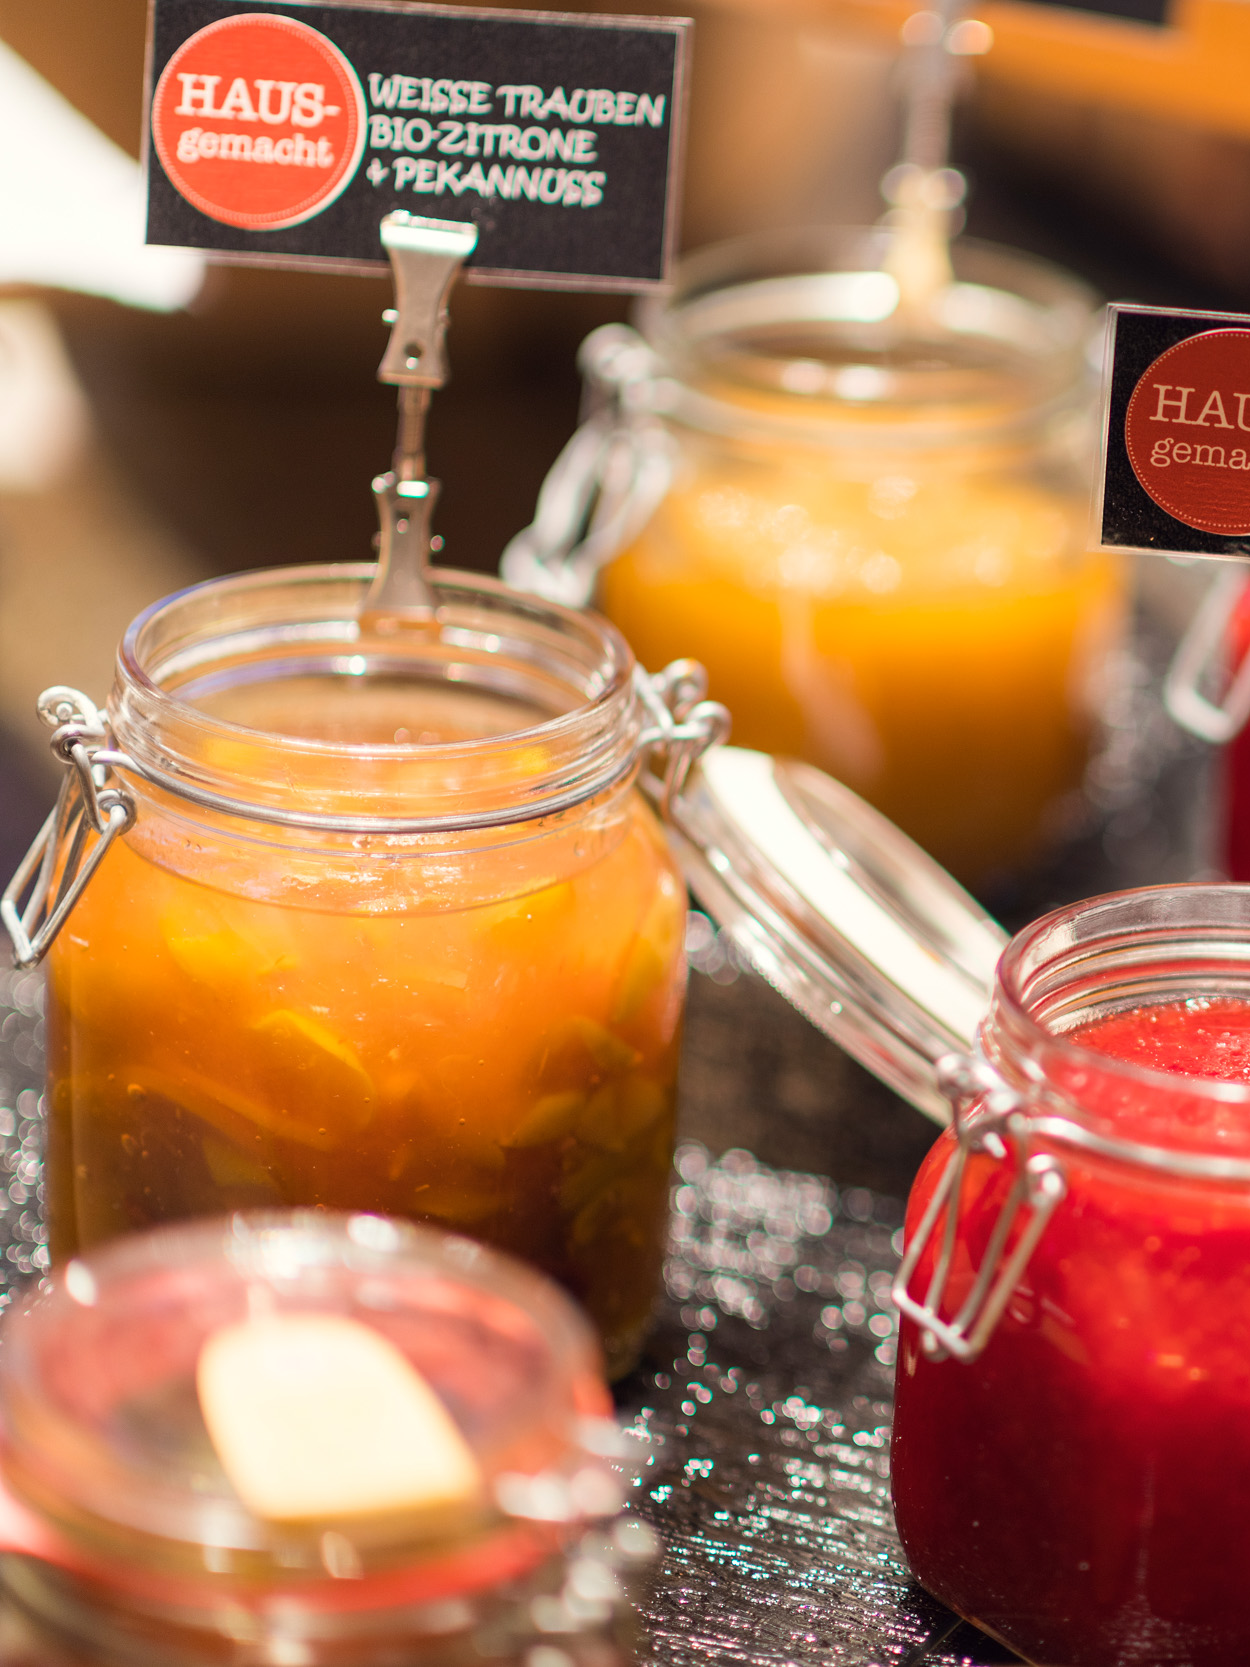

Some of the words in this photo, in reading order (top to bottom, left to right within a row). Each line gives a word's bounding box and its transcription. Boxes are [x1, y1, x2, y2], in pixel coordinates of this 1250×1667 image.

[175, 71, 341, 129] HAUS-
[367, 71, 494, 117] WEISSE
[495, 83, 667, 128] TRAUBEN
[175, 126, 334, 169] gemacht
[367, 113, 599, 164] BIO-ZITRONE
[366, 157, 389, 188] +
[392, 157, 607, 208] PEKANNUSS
